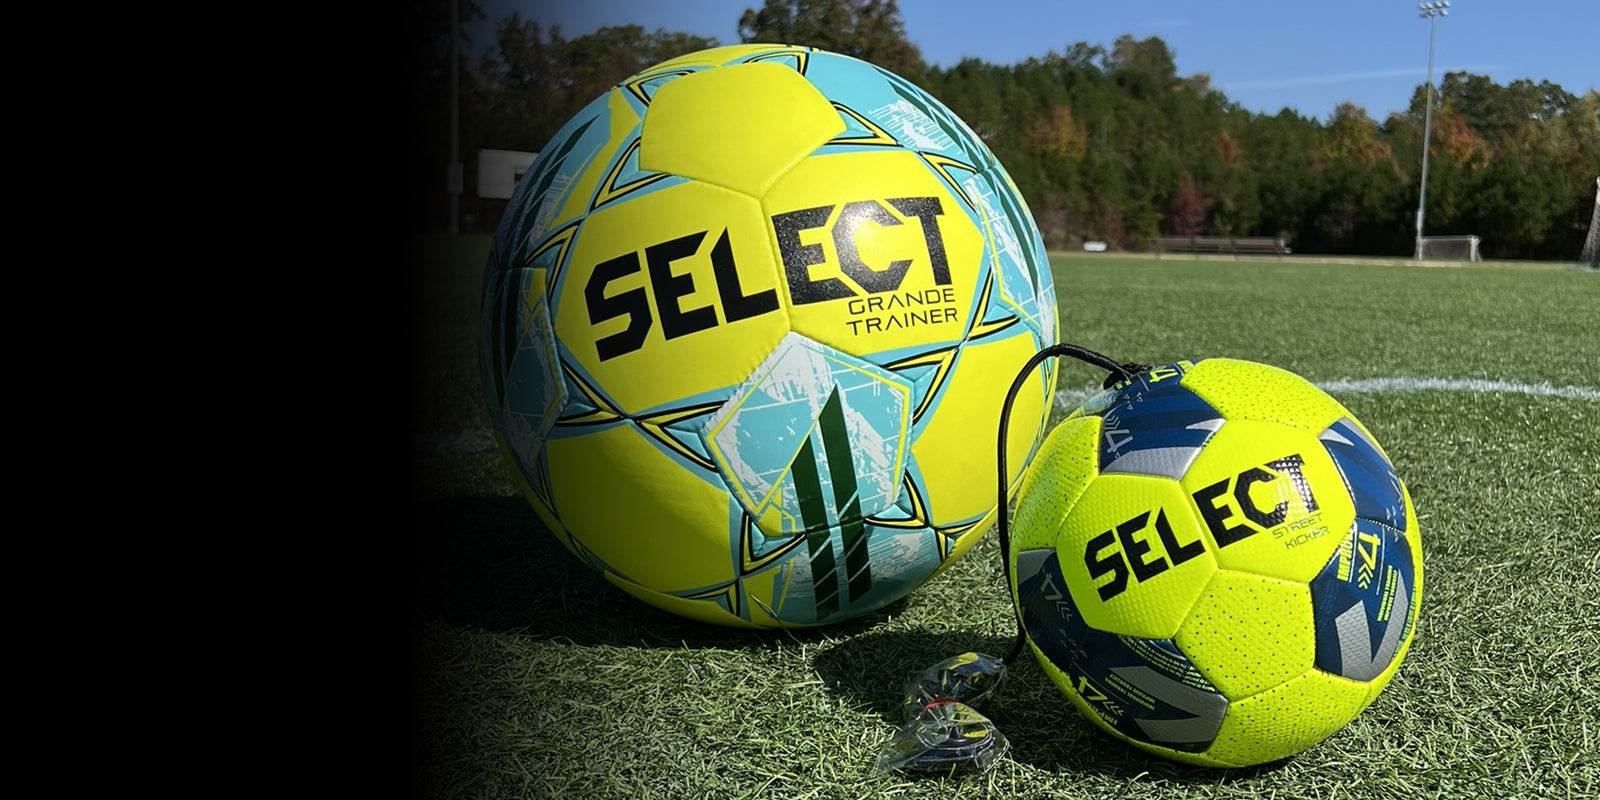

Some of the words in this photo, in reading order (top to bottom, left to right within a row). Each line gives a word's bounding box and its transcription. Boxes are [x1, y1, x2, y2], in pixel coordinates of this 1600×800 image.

[584, 196, 952, 363] SELECT
[847, 287, 956, 316] GRANDE
[846, 307, 958, 336] TRAINER
[1083, 453, 1320, 603] SELECT
[1272, 513, 1323, 540] STREET
[1284, 526, 1331, 550] KICKER
